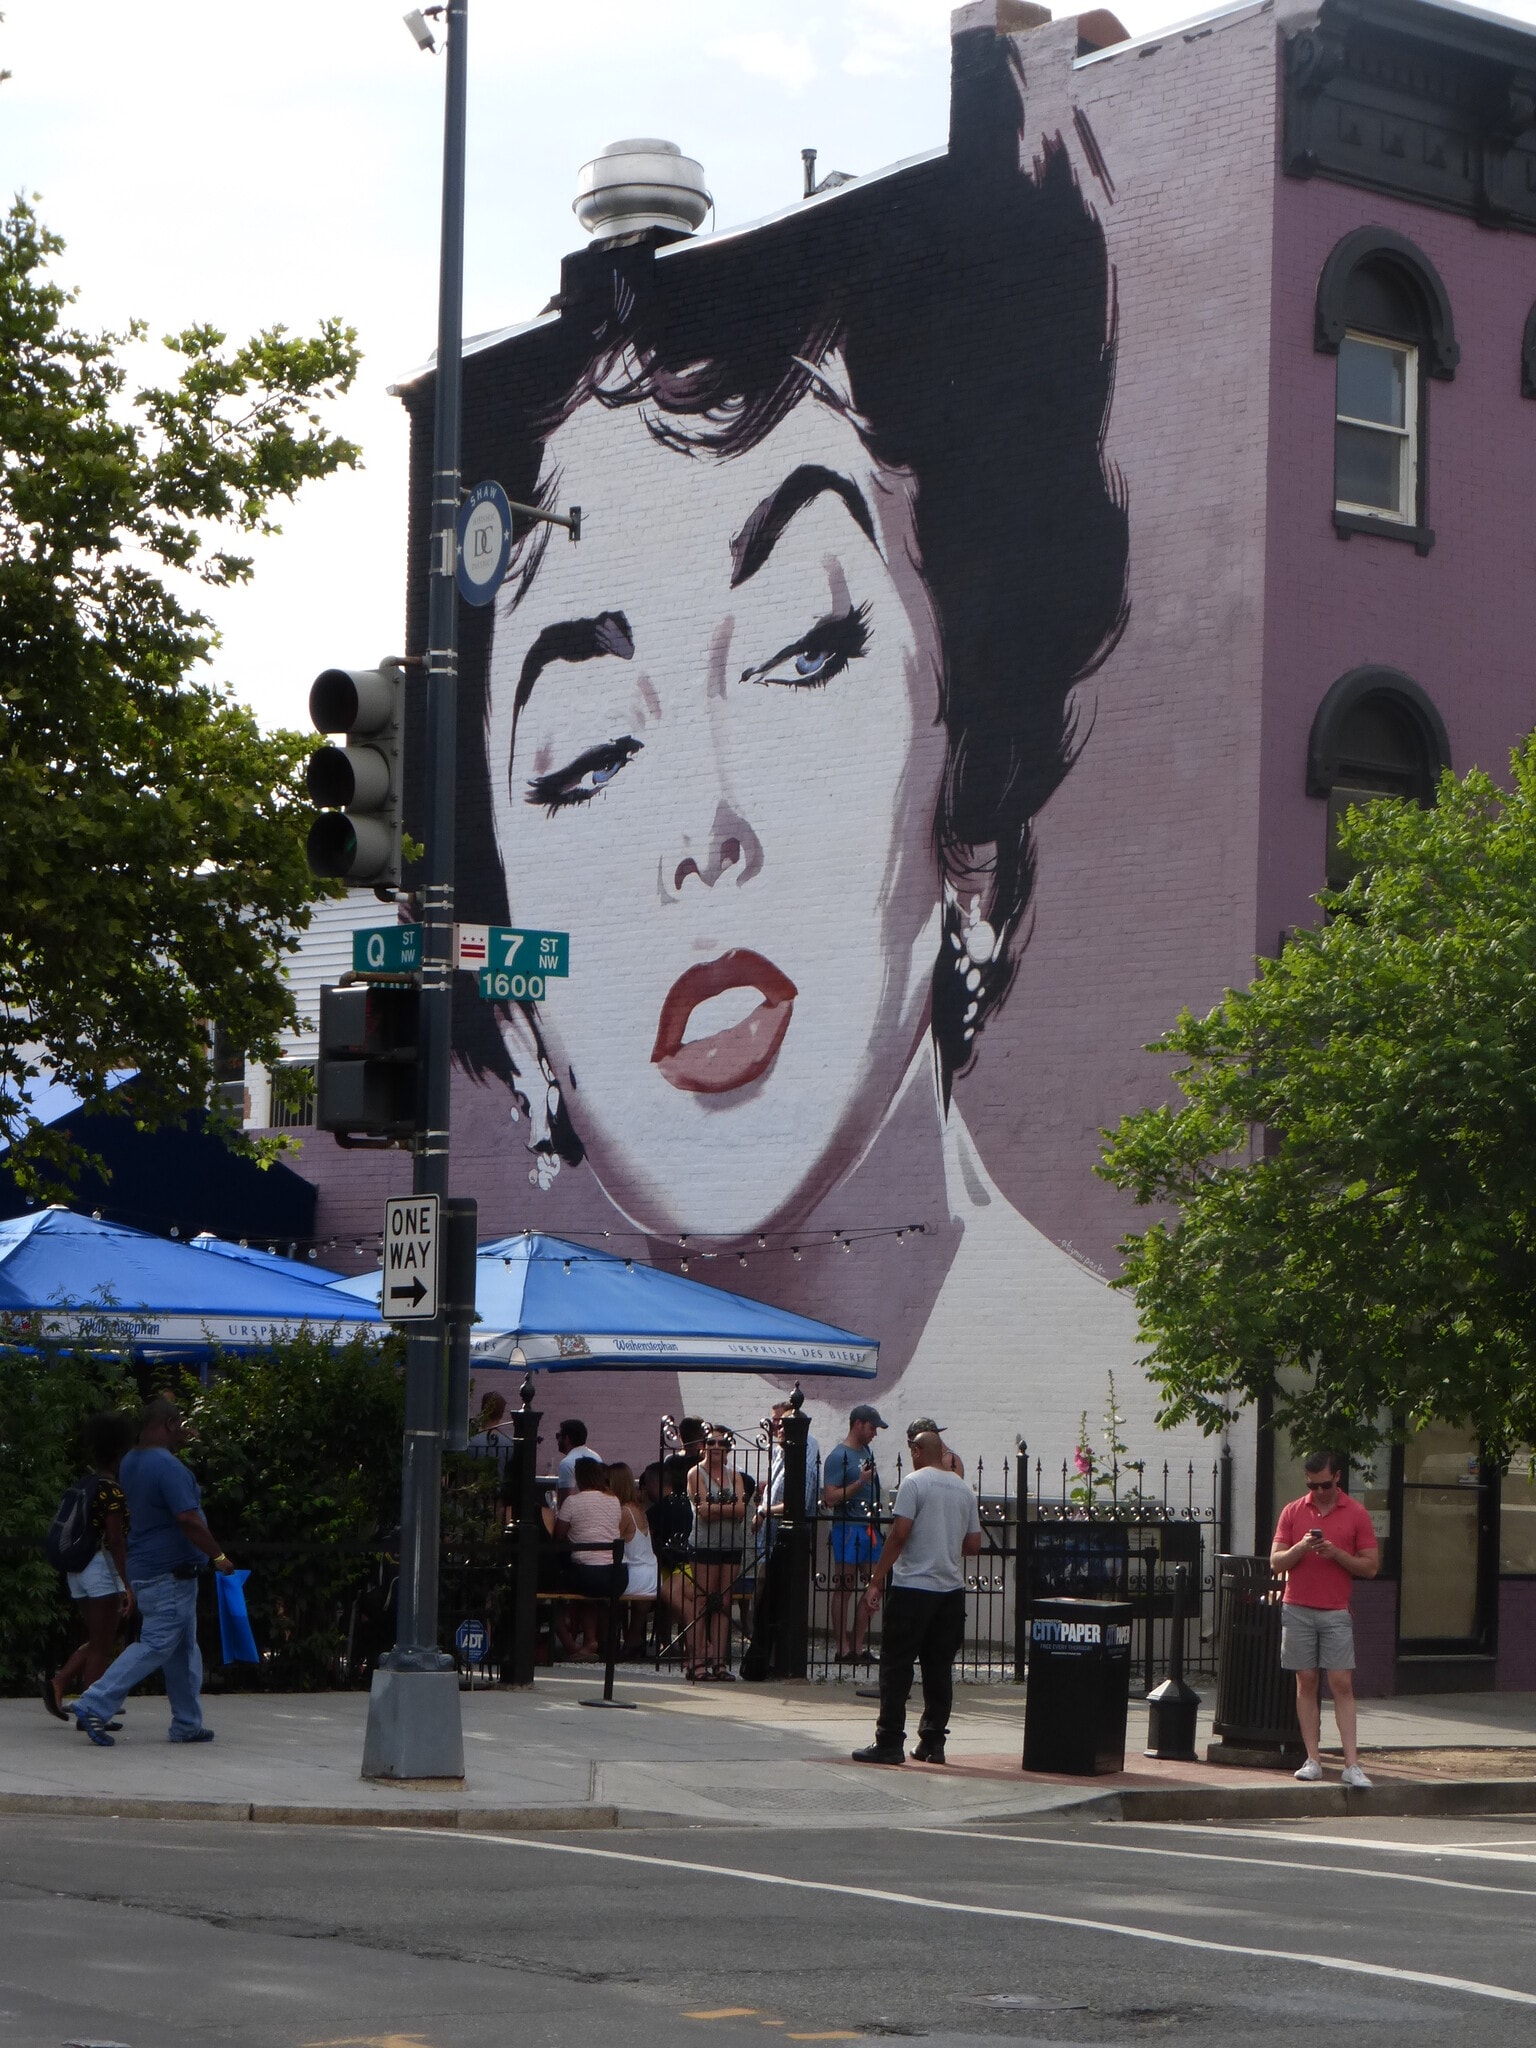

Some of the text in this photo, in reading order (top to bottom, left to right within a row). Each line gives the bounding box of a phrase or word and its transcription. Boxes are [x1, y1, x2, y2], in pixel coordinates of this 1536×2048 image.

[470, 485, 497, 507] SHAW
[474, 526, 494, 558] DC
[366, 931, 415, 968] Q ST
[401, 949, 416, 964] NW
[500, 934, 559, 967] 7 ST
[538, 954, 559, 970] NW
[482, 973, 544, 999] 1600
[391, 1207, 430, 1236] ONE
[390, 1240, 431, 1270] WAY
[613, 1339, 867, 1363] Weihenstephan URSPRUNG DES BIERES
[461, 1633, 484, 1649] ADT
[1040, 1643, 1052, 1651] FREE
